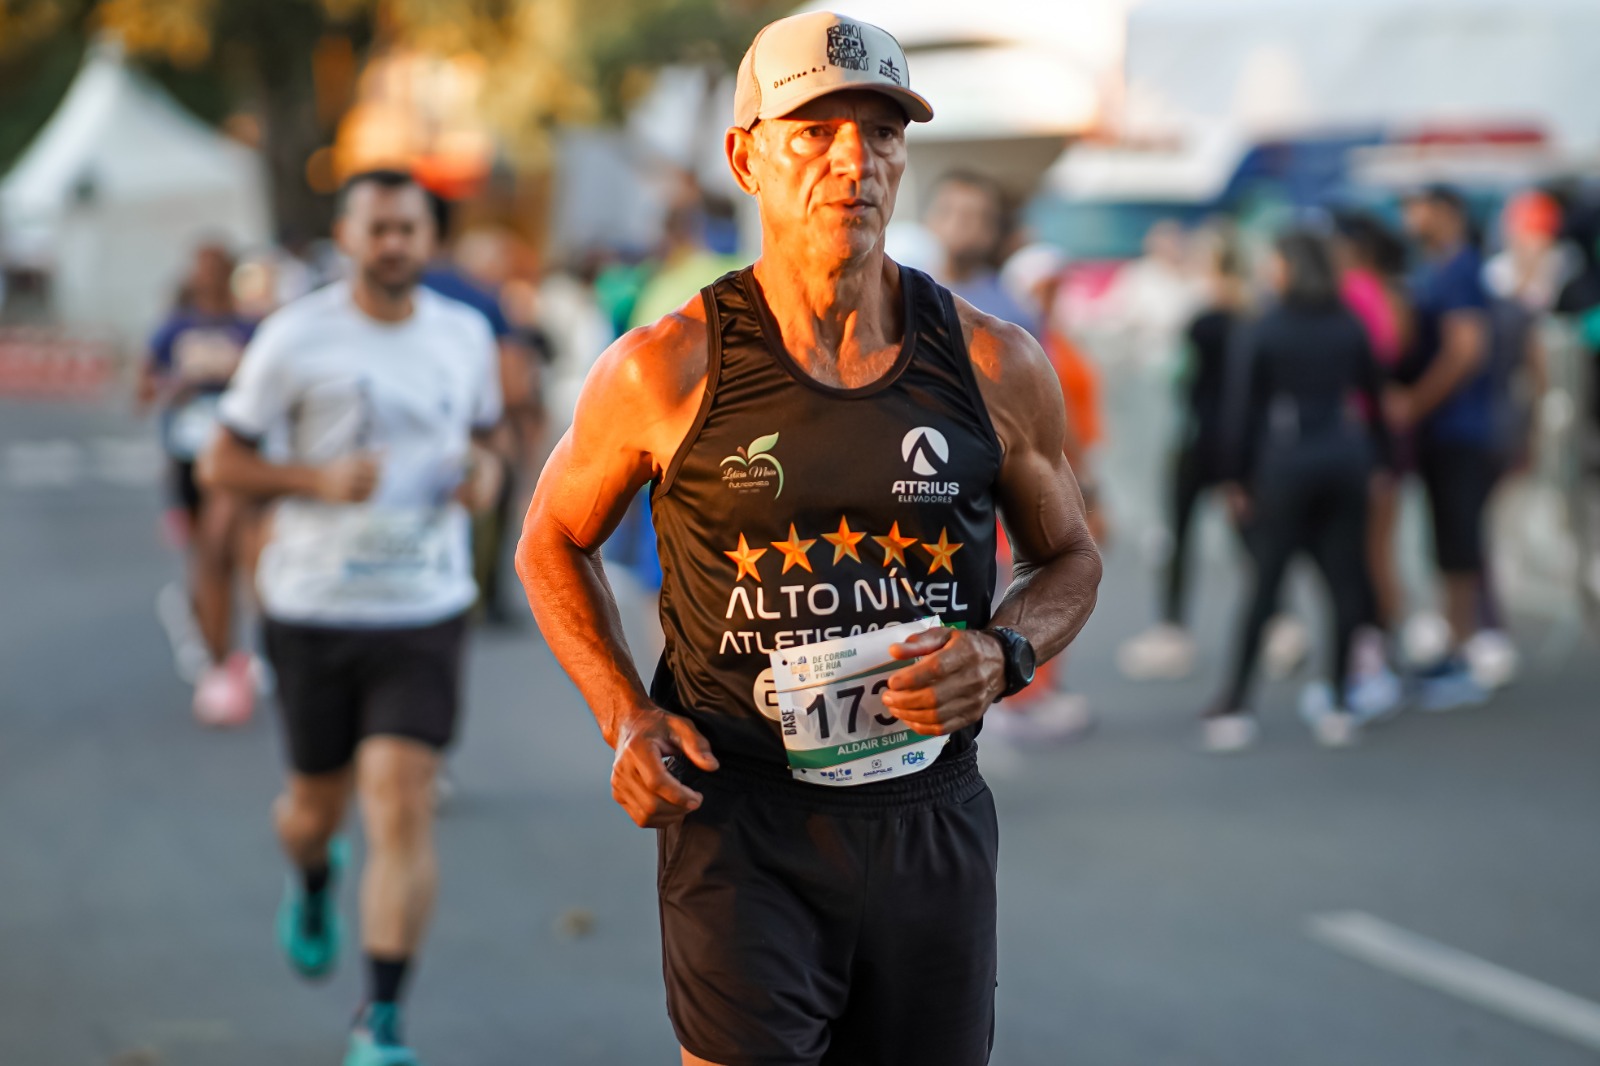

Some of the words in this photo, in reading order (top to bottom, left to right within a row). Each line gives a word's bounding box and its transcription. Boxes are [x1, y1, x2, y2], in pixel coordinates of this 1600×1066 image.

[891, 480, 960, 496] ATRIUS
[898, 495, 953, 504] ELEVADORES
[725, 583, 840, 620] ALTO
[853, 567, 969, 614] NÍVEL
[812, 655, 822, 665] DE
[824, 648, 857, 662] CORRIDA
[826, 660, 841, 670] RUA
[781, 708, 798, 736] BASE
[837, 737, 879, 756] ALDAIR
[882, 732, 909, 746] SUIM
